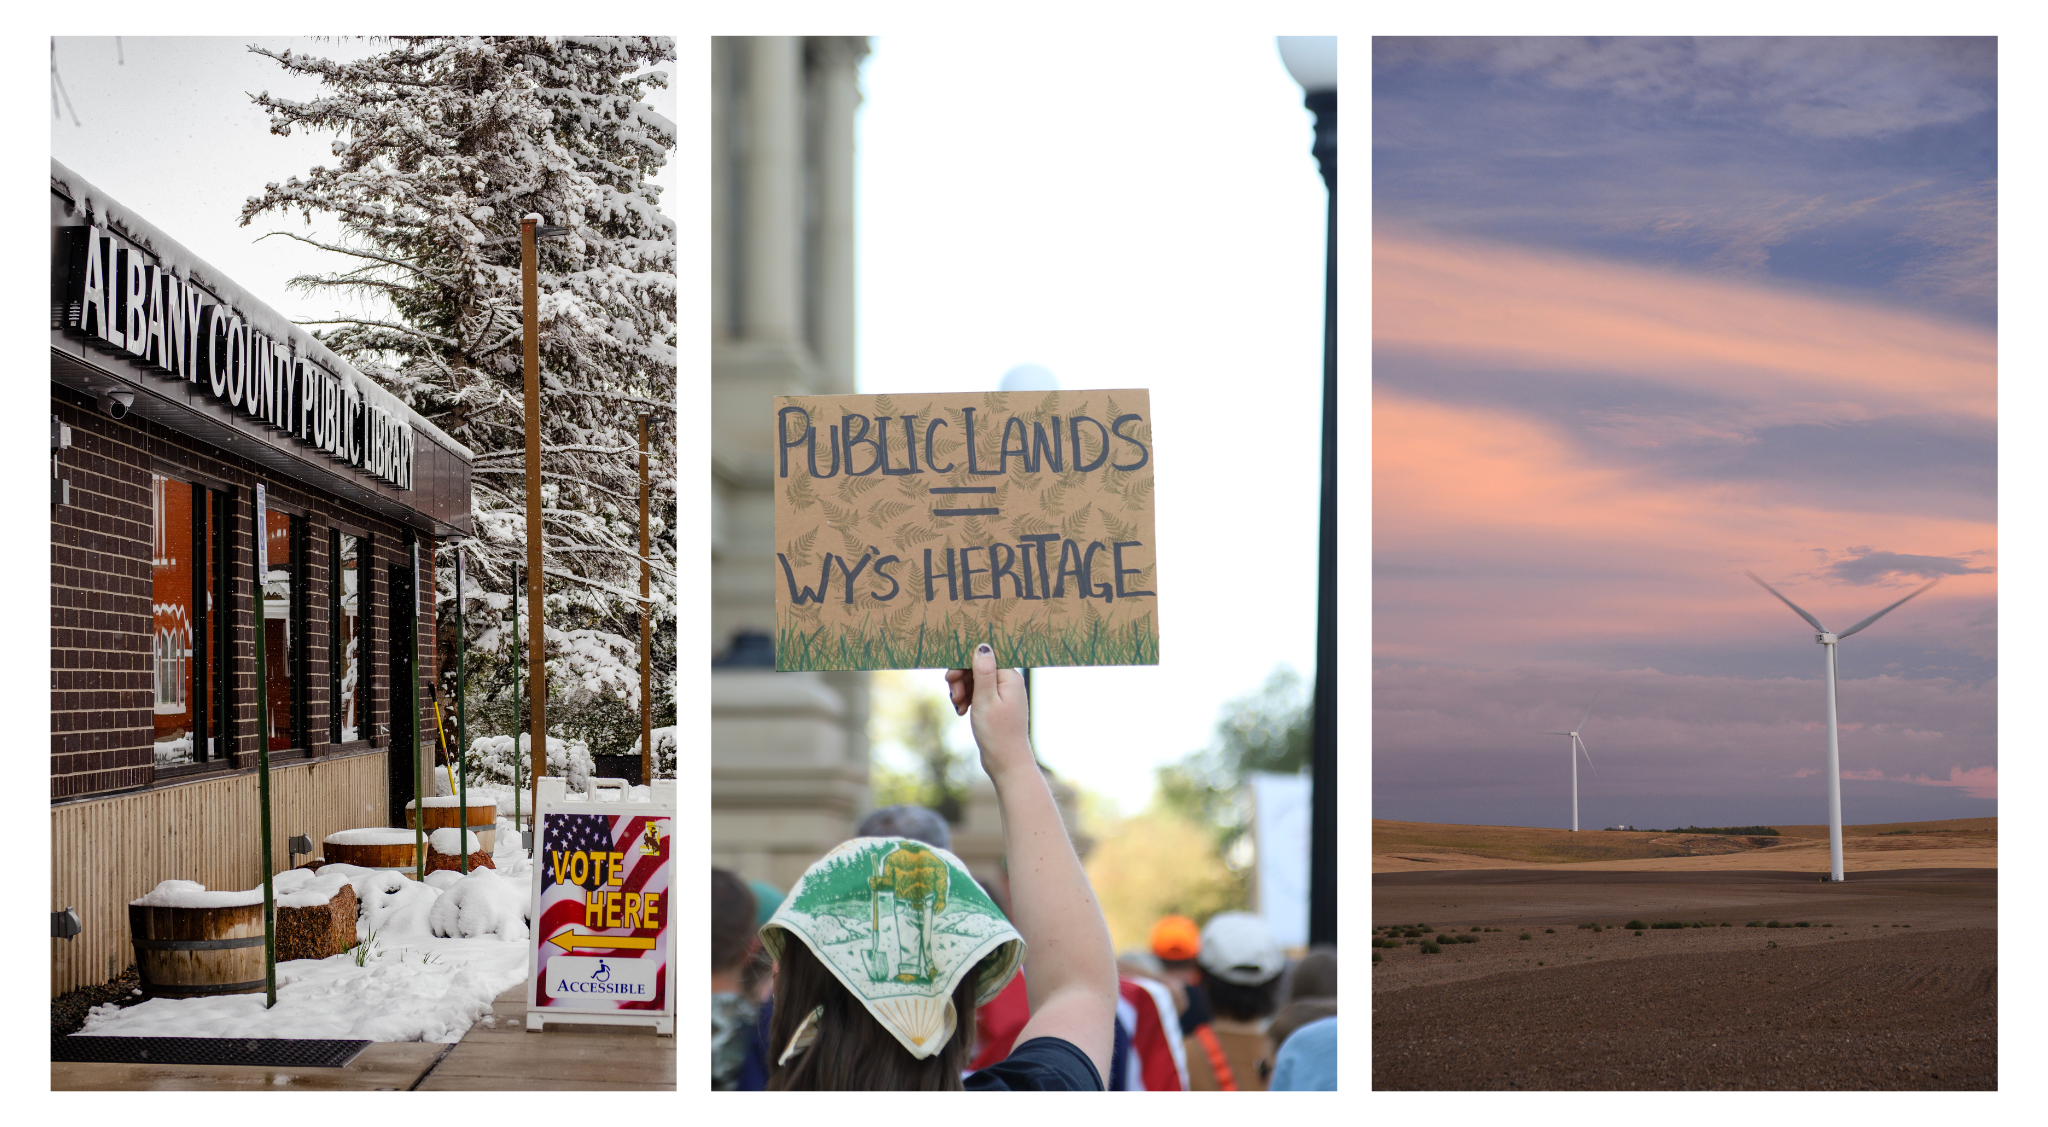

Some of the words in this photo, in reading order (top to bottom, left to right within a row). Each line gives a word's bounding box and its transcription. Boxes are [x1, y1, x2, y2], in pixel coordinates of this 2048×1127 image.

[80, 225, 202, 383] ALBANY
[208, 303, 297, 433] COUNTY
[301, 362, 360, 466] PUBLIC
[364, 401, 414, 491] LIBRARY
[778, 406, 954, 479] PUBLIC
[961, 406, 1149, 476] LANDS
[776, 545, 902, 606] WY'S
[923, 532, 1157, 604] HERITAGE
[551, 850, 624, 887] VOTE
[584, 890, 660, 930] HERE
